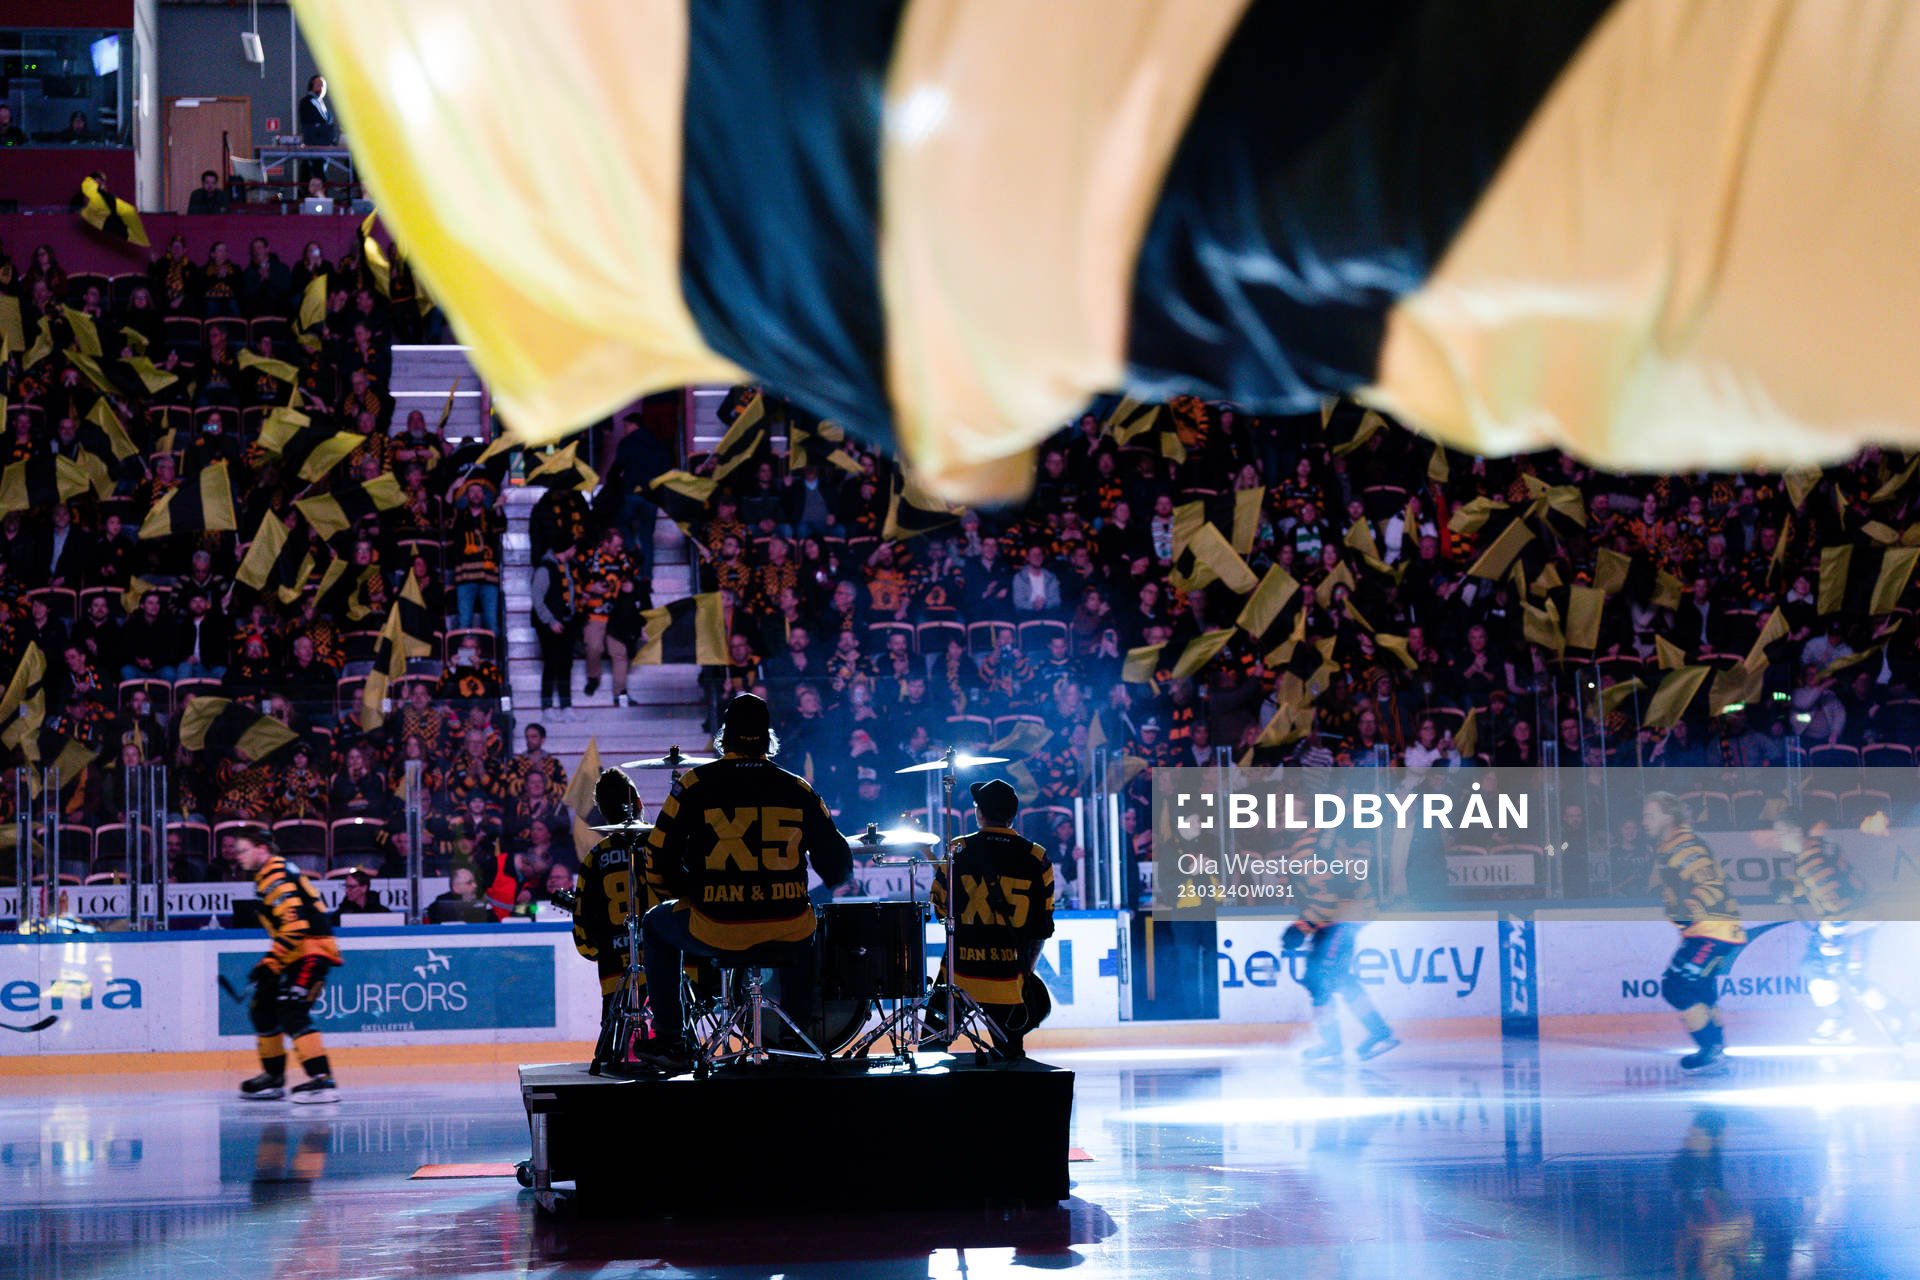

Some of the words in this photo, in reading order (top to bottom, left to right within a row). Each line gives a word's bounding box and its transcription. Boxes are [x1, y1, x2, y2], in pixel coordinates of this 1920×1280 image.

[704, 807, 804, 871] X5
[703, 885, 745, 902] DAN
[752, 885, 764, 900] &
[960, 873, 1032, 928] X5
[959, 946, 986, 961] DAN
